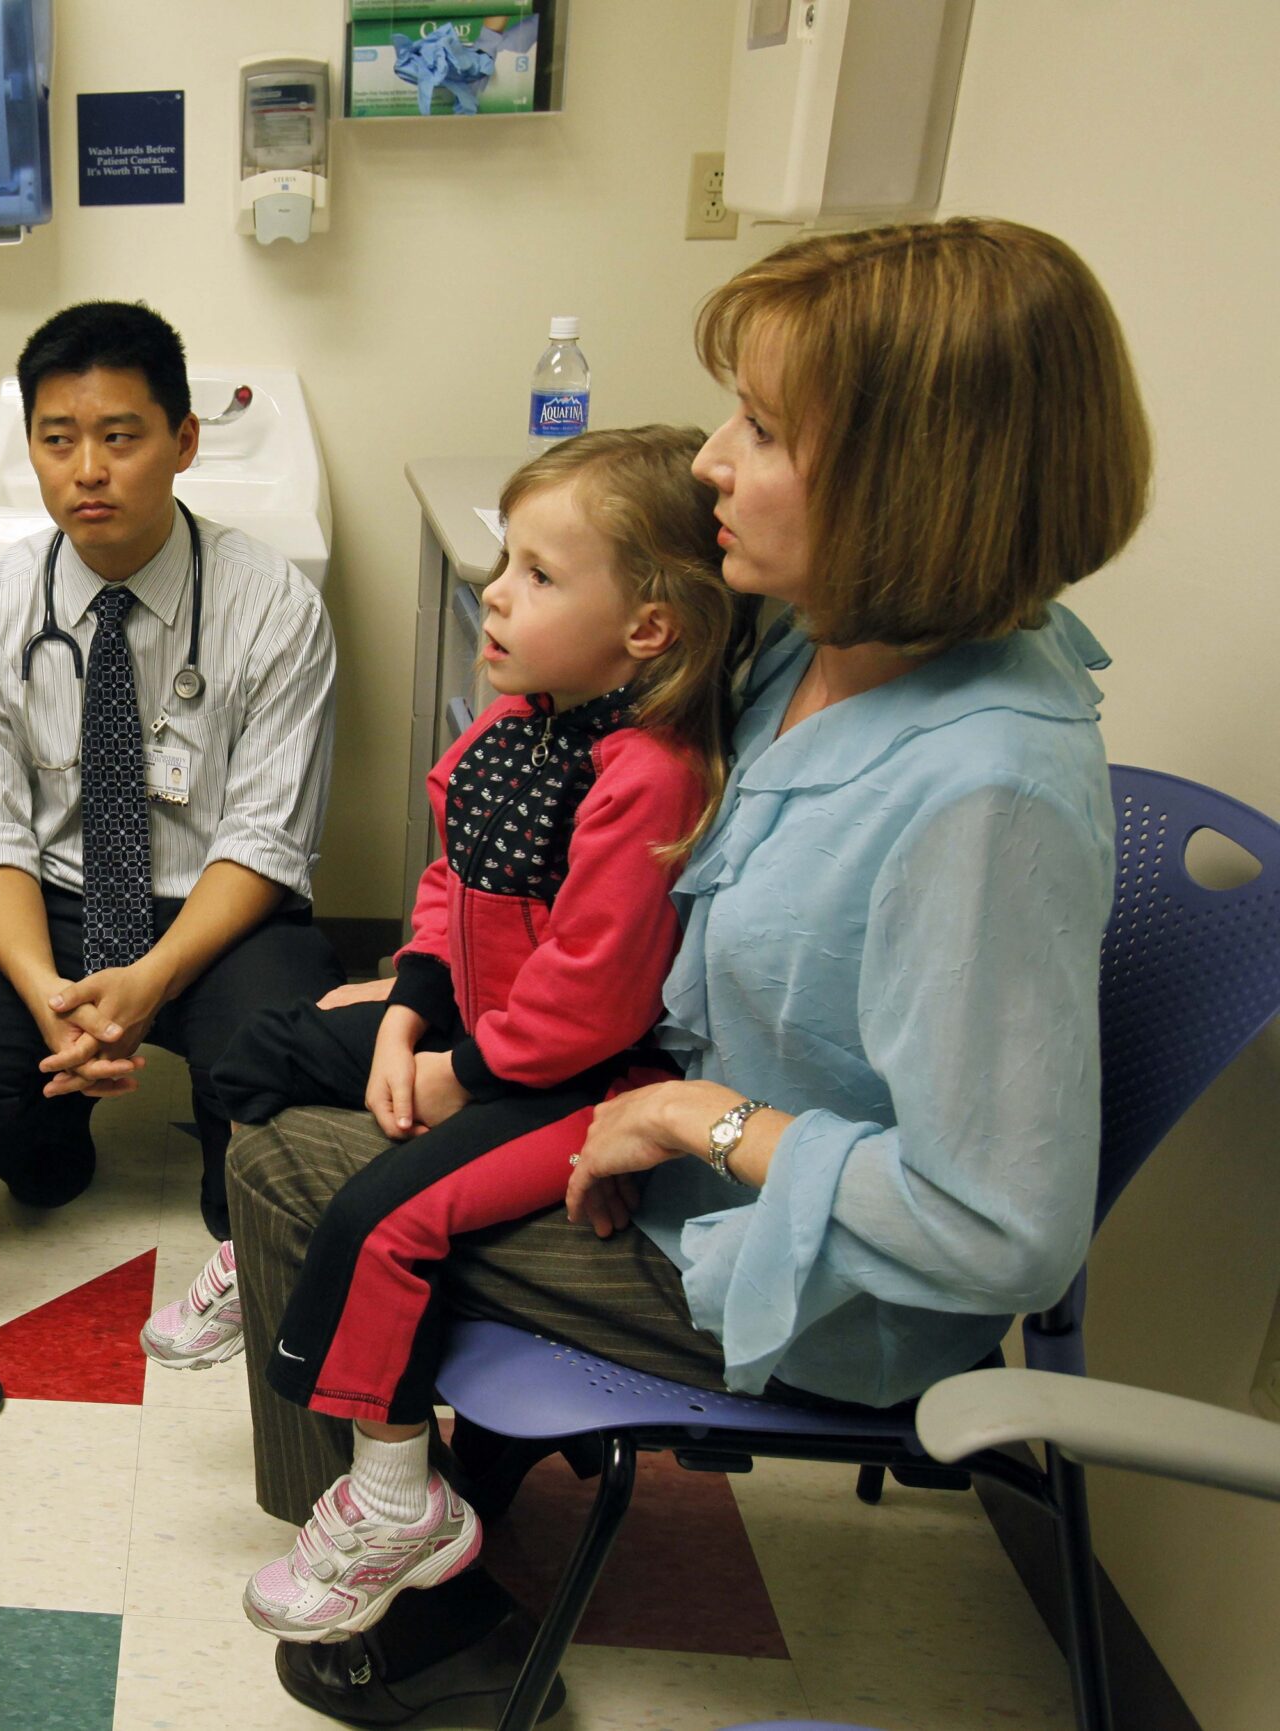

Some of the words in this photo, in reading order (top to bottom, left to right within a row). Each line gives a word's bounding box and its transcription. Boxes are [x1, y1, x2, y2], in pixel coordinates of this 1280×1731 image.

[419, 20, 472, 40] CAD
[518, 56, 528, 70] S
[88, 147, 113, 156] Wash
[114, 146, 144, 155] Hands
[146, 145, 177, 154] Before
[97, 157, 129, 166] Patient
[130, 155, 168, 165] Contact.
[87, 168, 102, 177] It's
[103, 166, 131, 176] Worth
[132, 166, 151, 175] The
[152, 165, 178, 174] Time.
[540, 403, 584, 424] AQUAFINA
